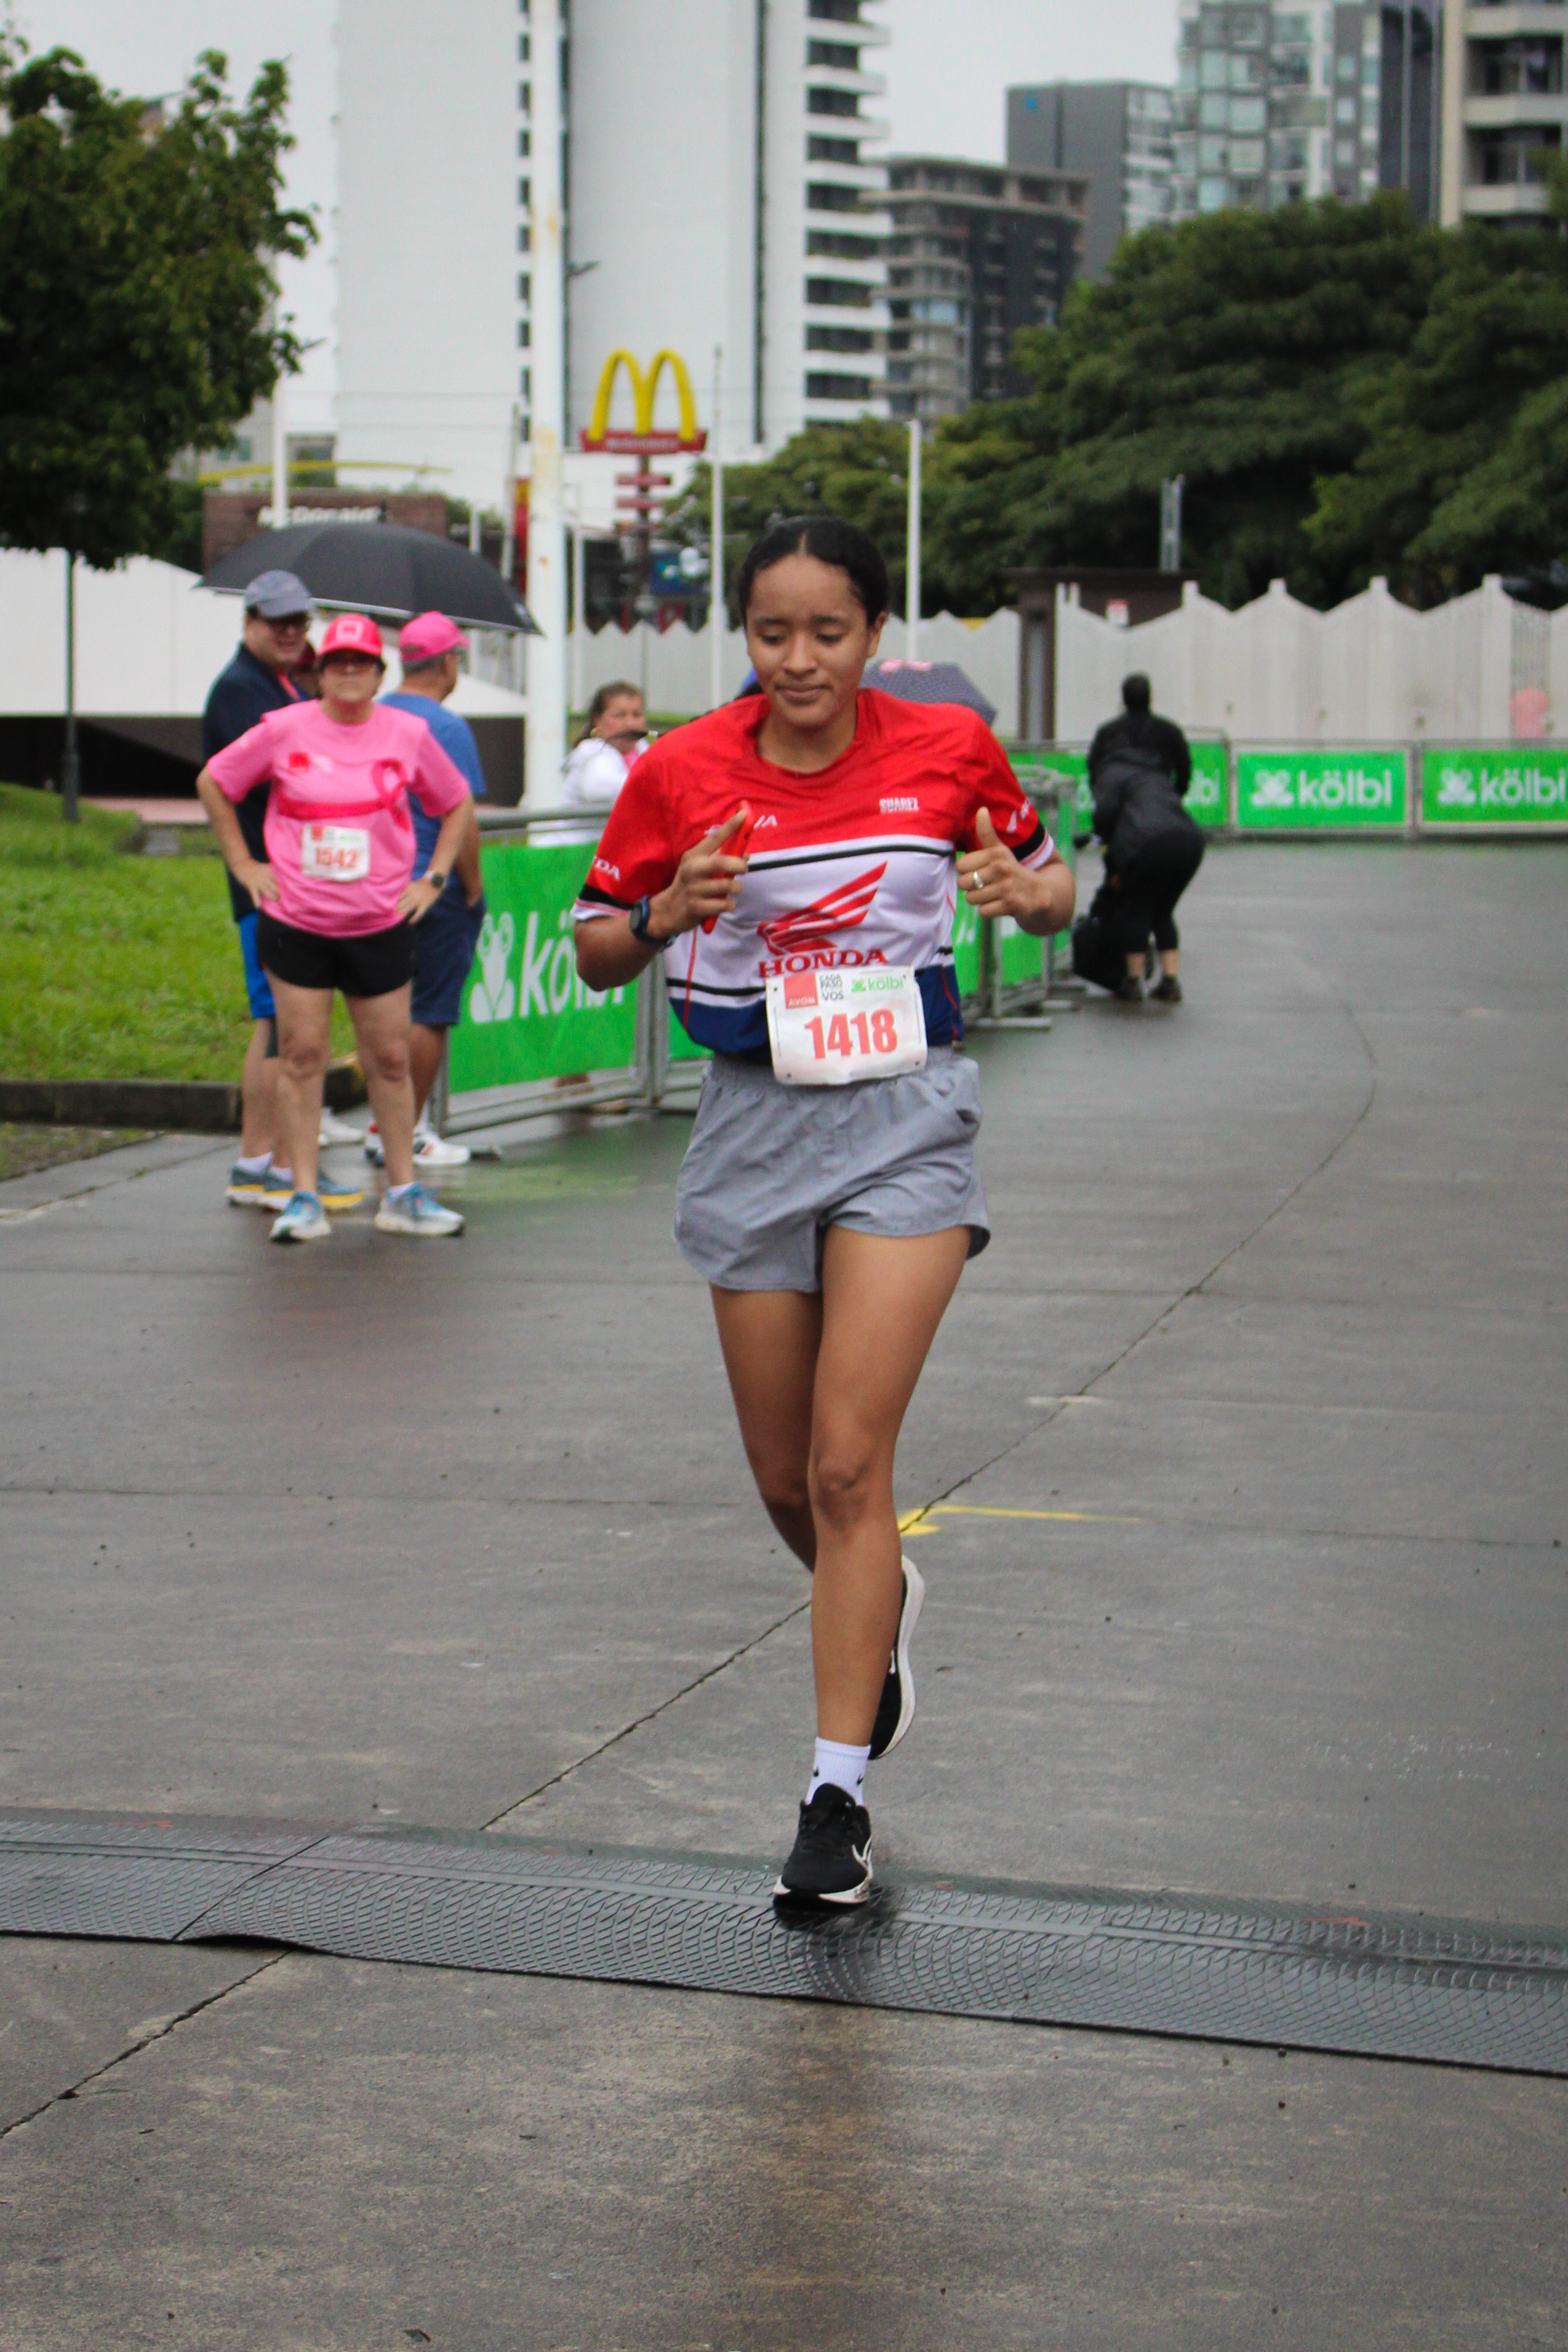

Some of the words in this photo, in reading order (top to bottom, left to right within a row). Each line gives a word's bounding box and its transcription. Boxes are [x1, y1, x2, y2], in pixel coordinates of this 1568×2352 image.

[1299, 769, 1392, 806] kölbi
[1481, 768, 1566, 805] kölbi
[759, 948, 889, 978] HONDA
[819, 973, 842, 981] CADA
[820, 979, 843, 988] PASO
[868, 976, 903, 991] kölbi
[788, 997, 815, 1006] AVON
[822, 990, 844, 1001] VOS
[804, 1009, 898, 1059] 1418
